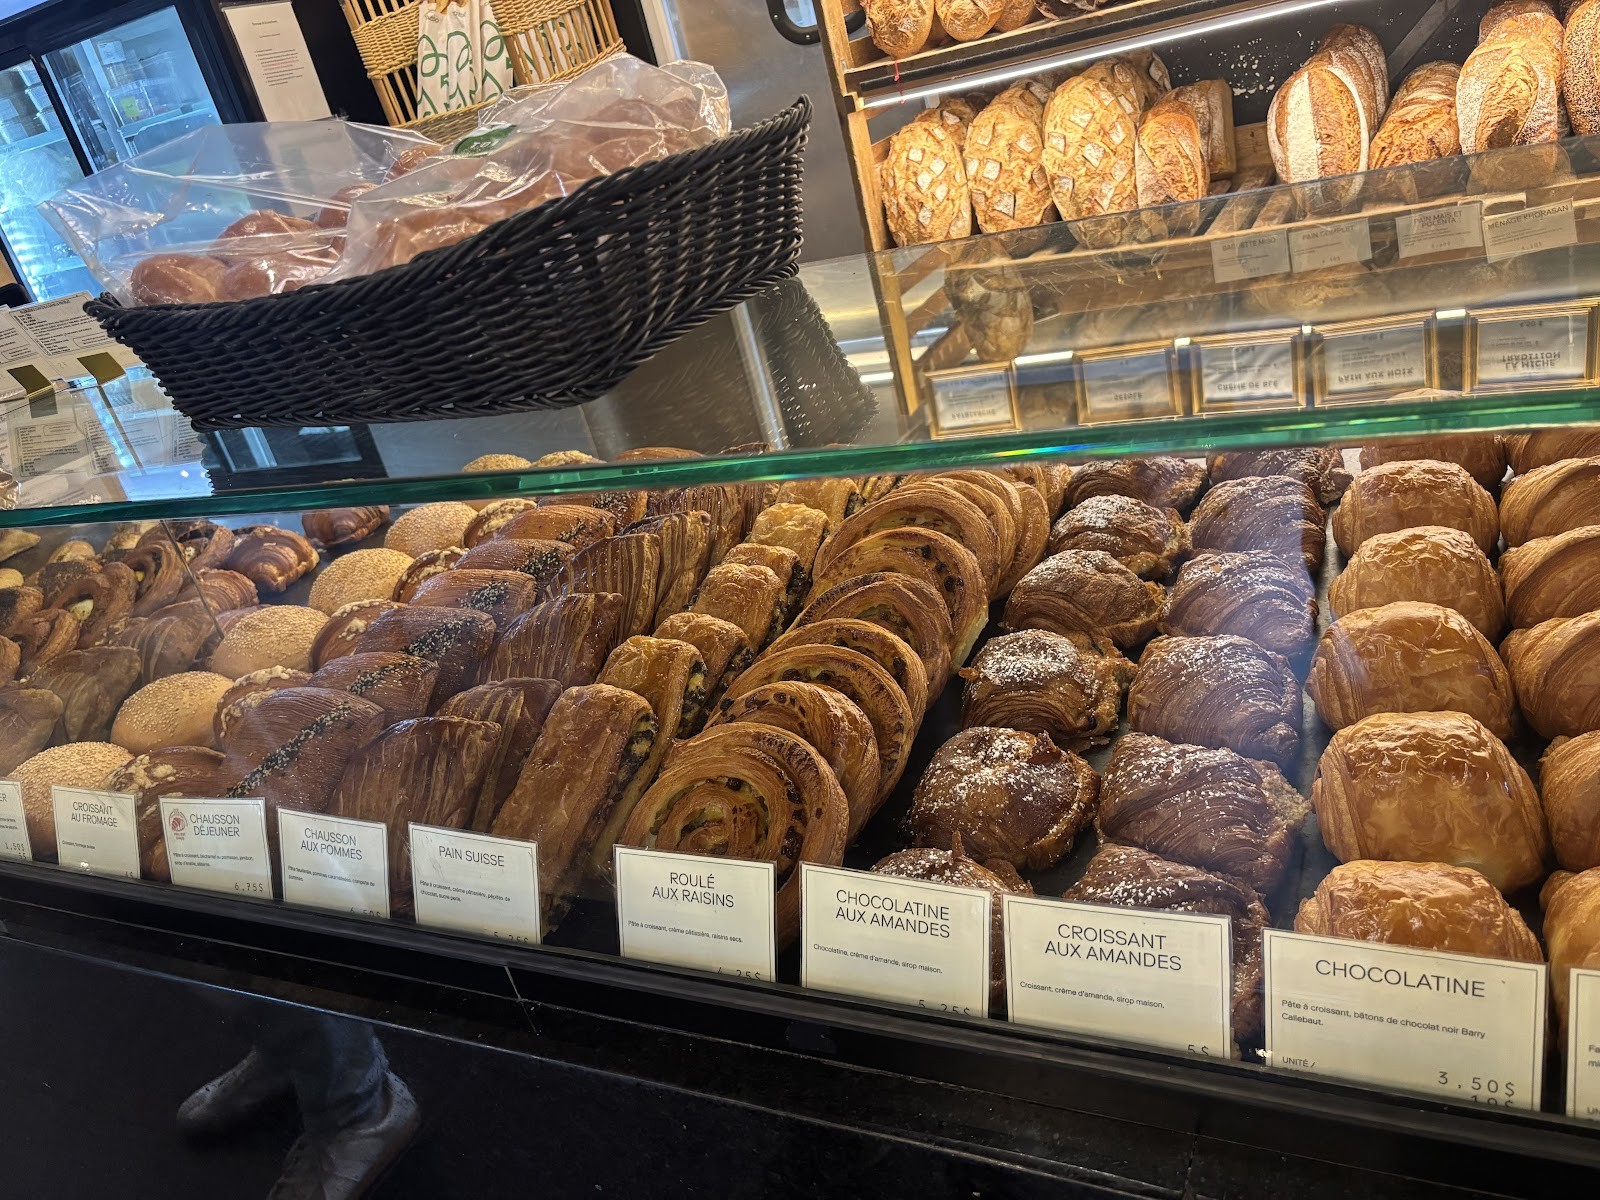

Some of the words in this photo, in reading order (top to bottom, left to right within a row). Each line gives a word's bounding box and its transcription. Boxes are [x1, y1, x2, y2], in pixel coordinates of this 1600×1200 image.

[73, 801, 113, 815] CROISSANT
[71, 813, 81, 822] AU
[82, 813, 118, 827] FROMAGE
[189, 813, 240, 825] CHAUSSON
[194, 824, 240, 837] DÉJEUNER
[304, 827, 357, 847] CHAUSSON
[300, 840, 319, 852] AUX
[320, 843, 363, 860] POMMES
[438, 845, 463, 860] PAIN
[465, 850, 505, 867] SUISSE
[669, 871, 715, 889] ROULÉ
[652, 885, 679, 901] AUX
[682, 888, 735, 908] RAISINS
[836, 889, 950, 921] CHOCOLATINE
[628, 920, 640, 928] Pâte
[644, 922, 668, 932] croissant,
[711, 932, 728, 941] raisins
[835, 906, 866, 924] AUX
[870, 912, 950, 938] AMANDES
[1057, 923, 1167, 950] CROISSANT
[813, 943, 849, 957] Chocolatine,
[849, 950, 869, 961] crème
[869, 952, 901, 967] d'amande,
[901, 960, 917, 971] sirop
[918, 964, 943, 974] maison.
[1045, 940, 1082, 959] AUX
[1086, 946, 1182, 971] AMANDES
[1315, 959, 1486, 998] CHOCOLATINE
[1019, 980, 1054, 993] Croissant,
[1054, 986, 1077, 997] crème
[1078, 990, 1115, 1002] d'amande,
[1116, 995, 1135, 1005] sirop
[1136, 998, 1165, 1009] maison.
[1281, 1012, 1324, 1026] Callebaut.
[1281, 999, 1302, 1010] Pâte
[1310, 1004, 1352, 1018] croissant,
[1353, 1009, 1384, 1023] bâtons
[1386, 1016, 1398, 1025] de
[1400, 1018, 1440, 1032] chocolat
[1442, 1025, 1459, 1034] noir
[1461, 1027, 1486, 1040] Barry
[1282, 1056, 1309, 1068] UNITÉ
